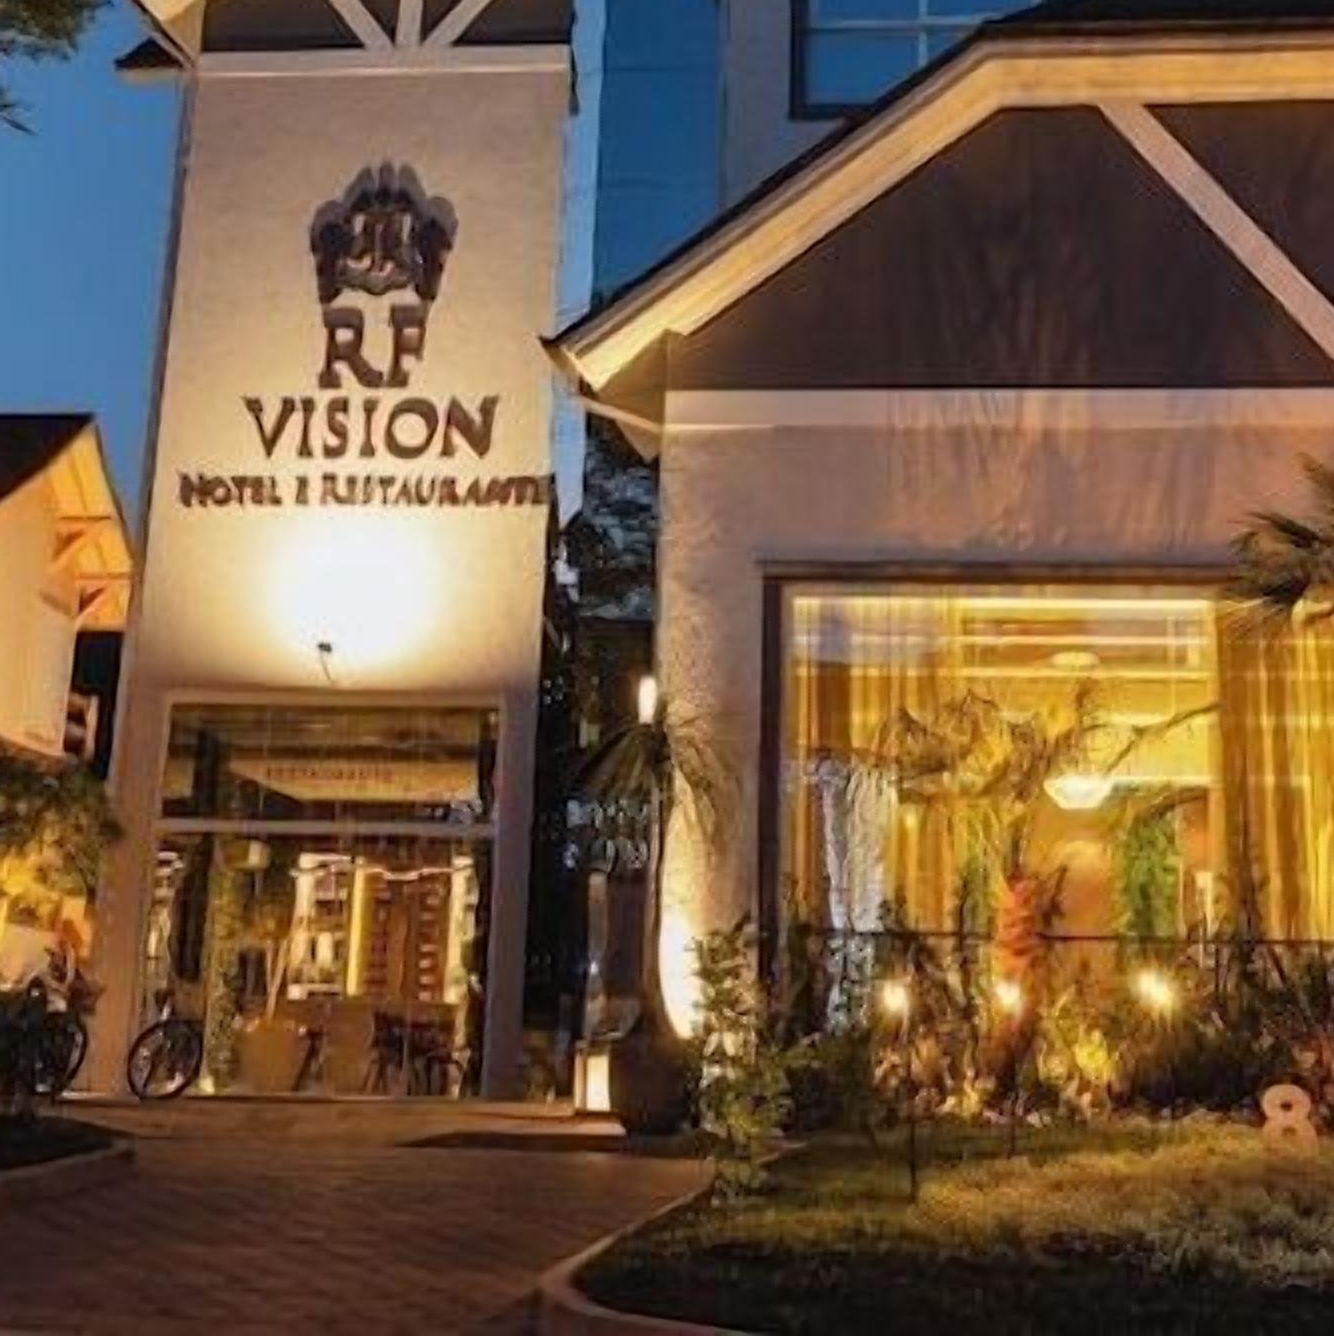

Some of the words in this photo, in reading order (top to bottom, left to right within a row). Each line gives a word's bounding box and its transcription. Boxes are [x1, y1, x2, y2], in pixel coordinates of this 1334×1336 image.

[318, 304, 430, 389] RF
[241, 395, 499, 459] VISION
[178, 472, 282, 508] HOTEL
